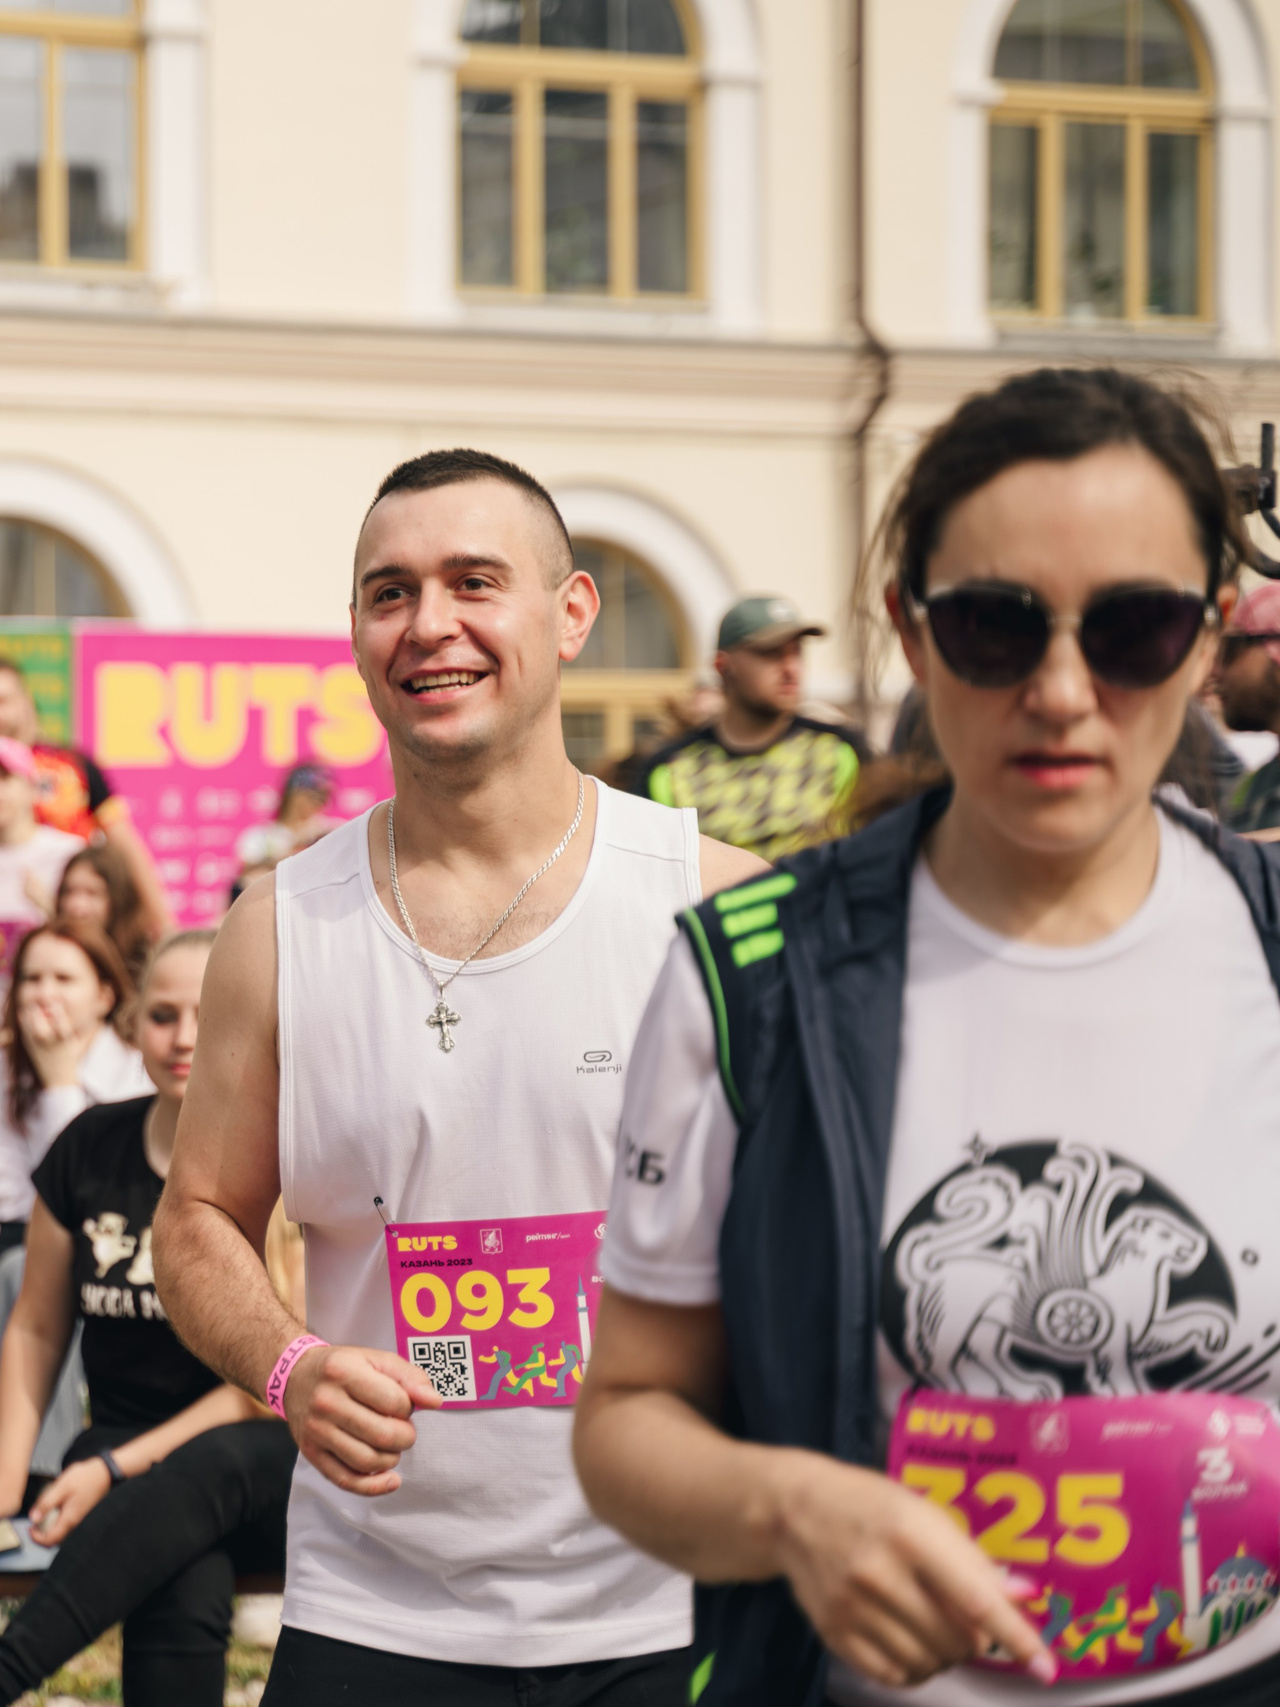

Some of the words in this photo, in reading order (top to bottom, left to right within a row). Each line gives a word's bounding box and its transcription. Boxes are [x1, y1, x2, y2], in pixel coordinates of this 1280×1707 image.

[94, 661, 384, 768] RUTS
[576, 1064, 622, 1074] Kalenji
[397, 1235, 458, 1252] RUTS
[400, 1260, 445, 1268] КАЗАНЬ
[447, 1258, 474, 1266] 2023
[400, 1267, 555, 1333] 093
[900, 1463, 1131, 1566] 325
